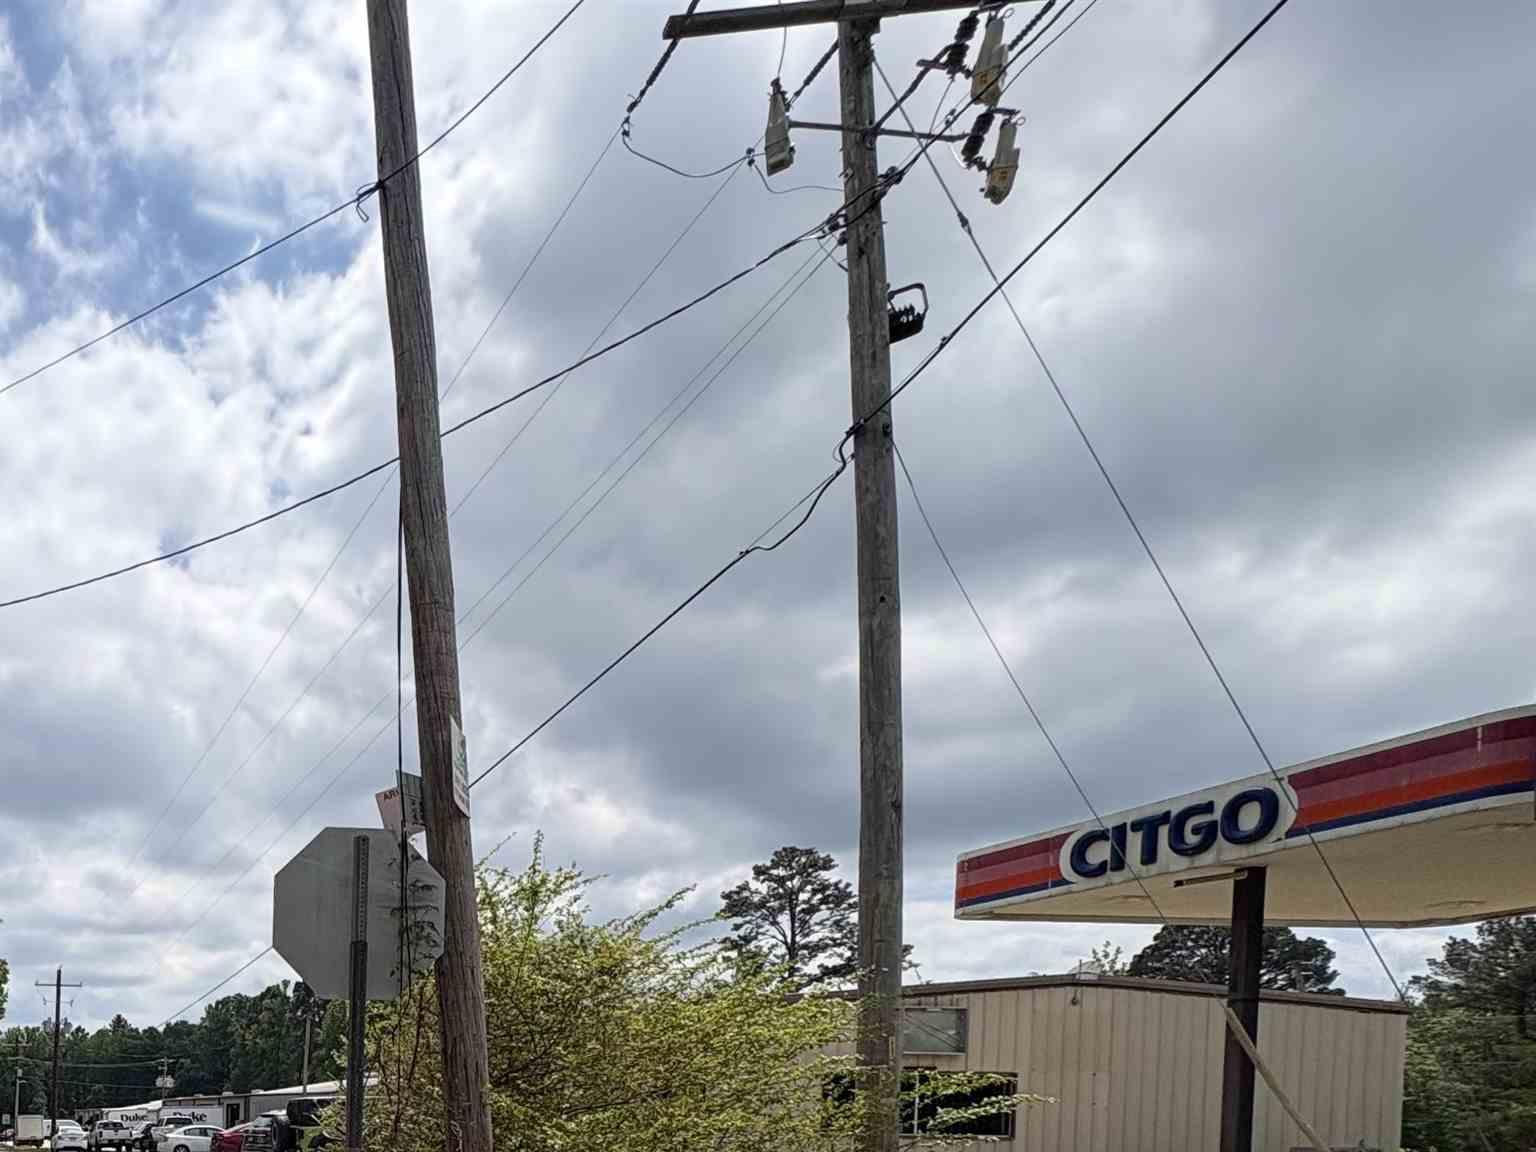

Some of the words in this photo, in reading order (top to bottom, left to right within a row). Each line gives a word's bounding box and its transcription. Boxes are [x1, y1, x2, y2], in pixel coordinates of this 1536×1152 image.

[1070, 787, 1279, 878] CITGO
[120, 1113, 148, 1121] Duke
[173, 1111, 207, 1121] Dke
